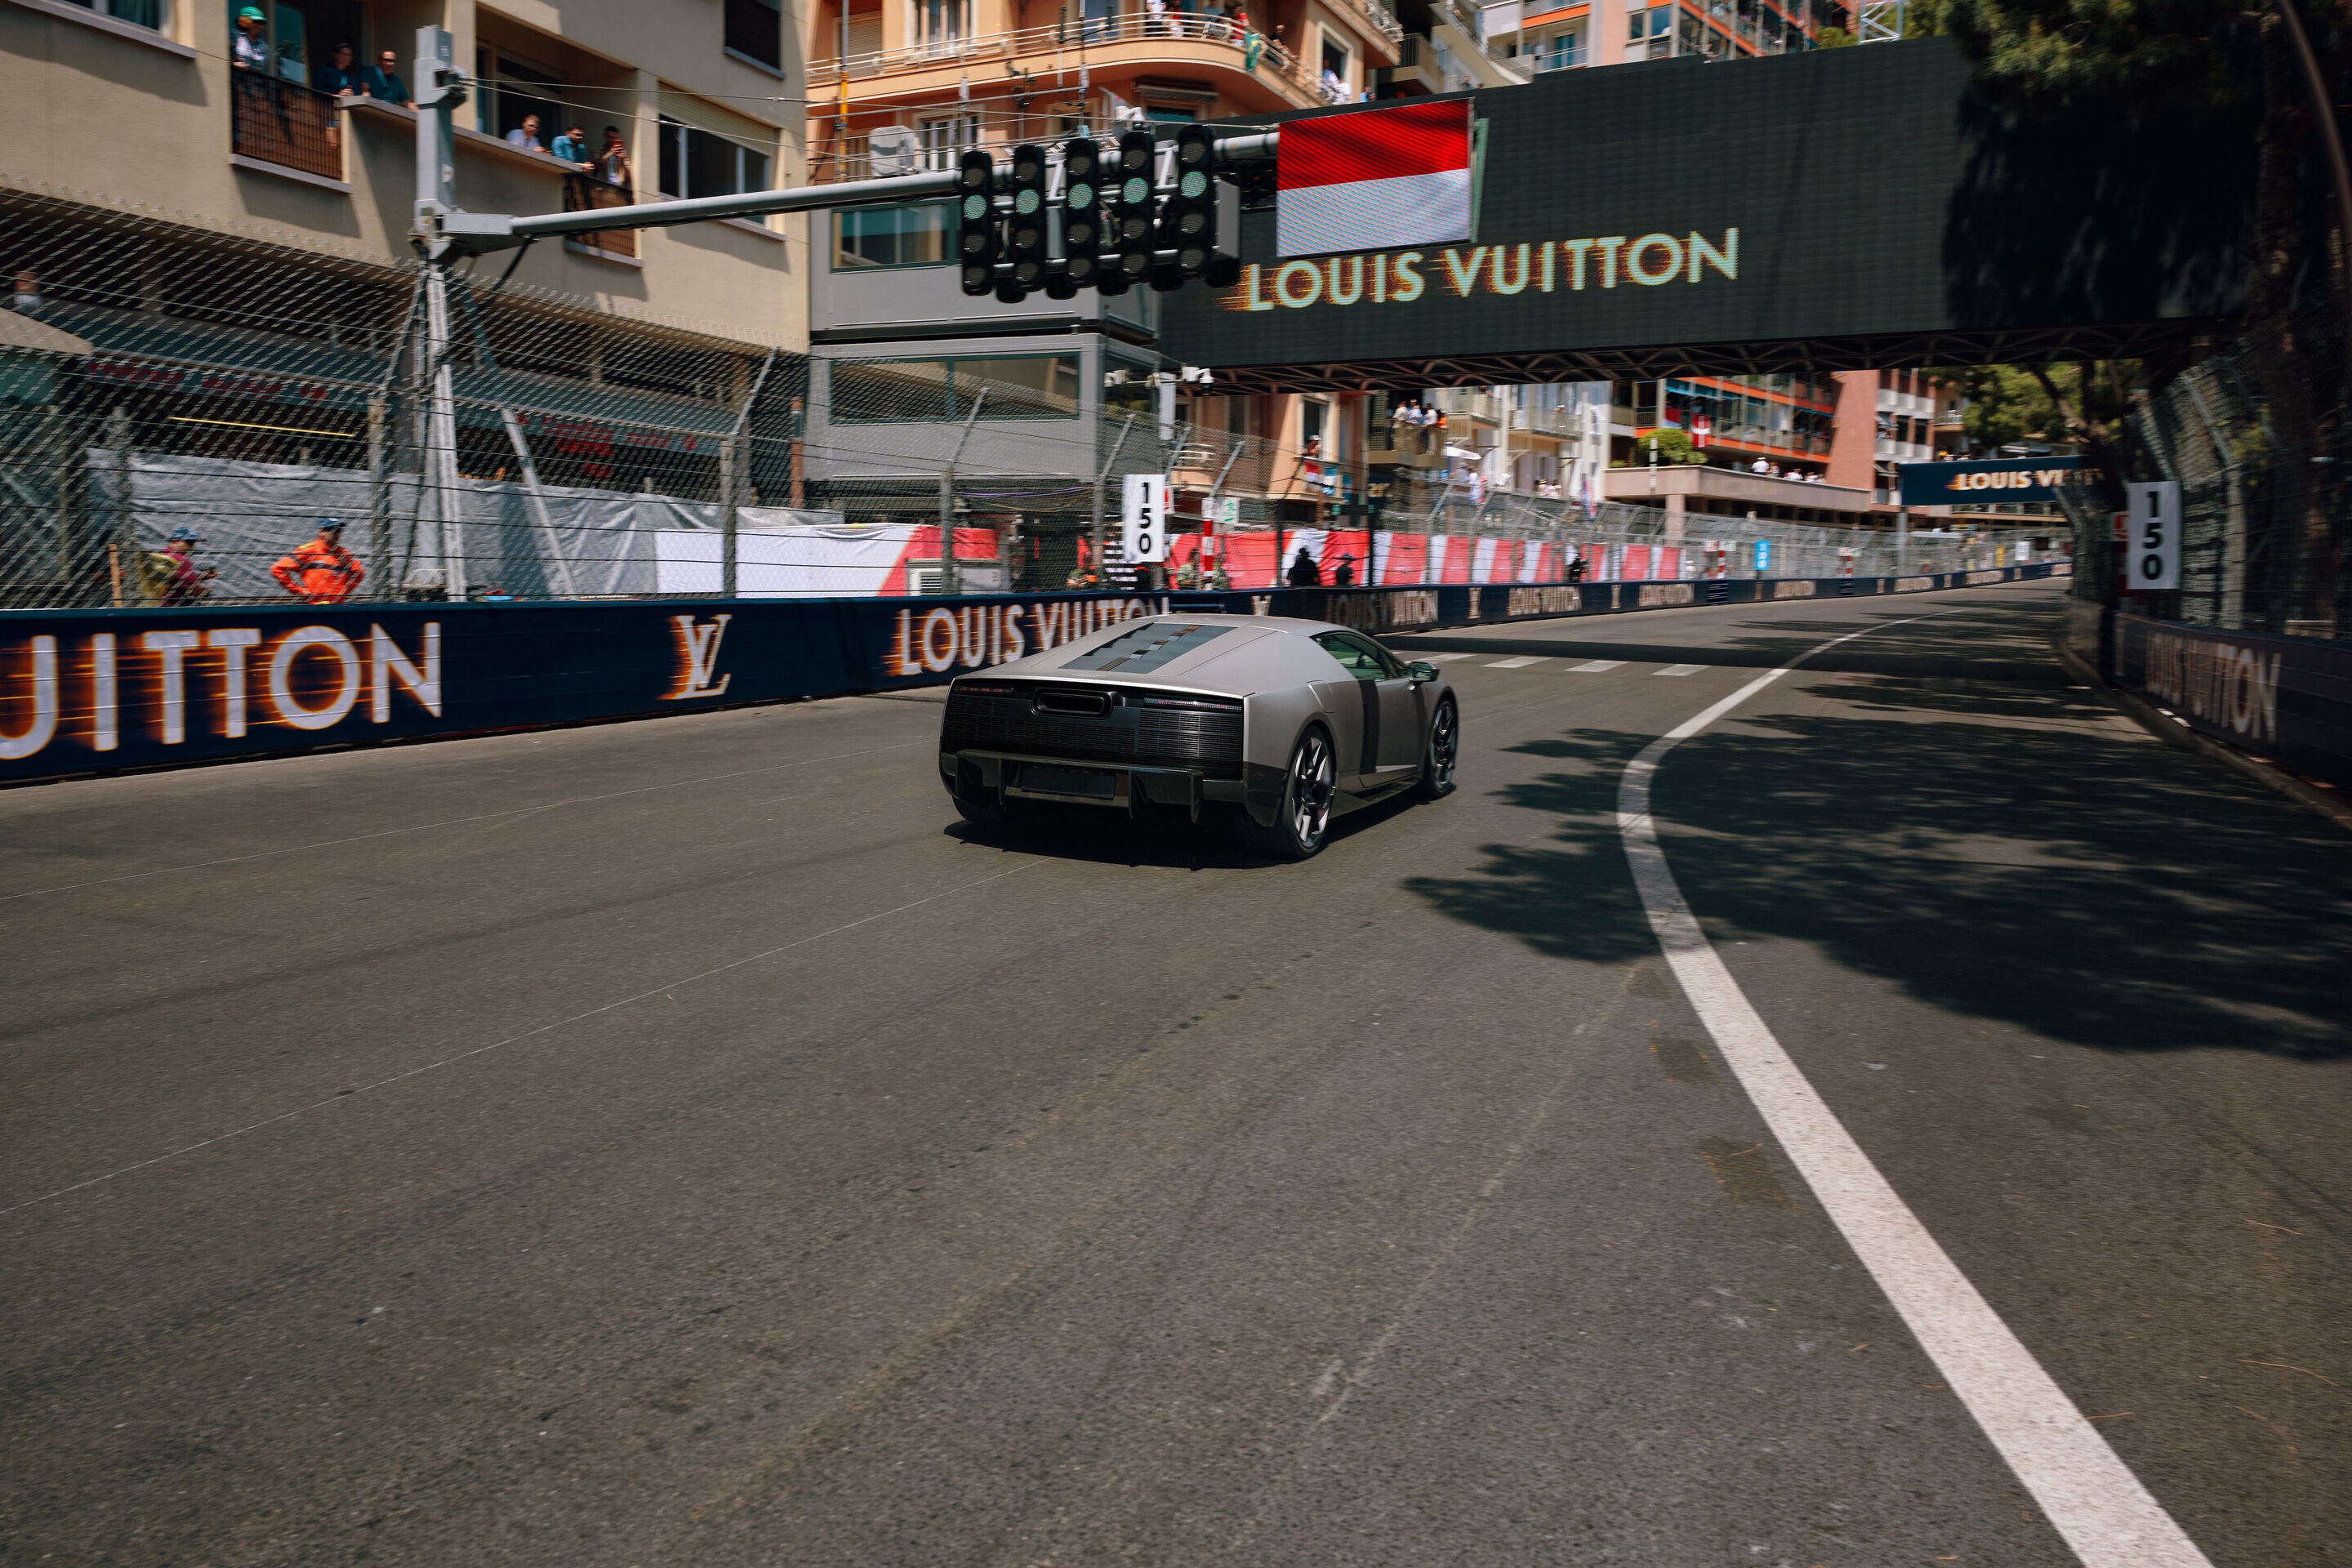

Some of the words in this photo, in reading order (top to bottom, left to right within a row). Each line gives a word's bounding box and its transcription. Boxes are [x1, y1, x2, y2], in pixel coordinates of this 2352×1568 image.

[1245, 252, 1426, 312] LOUIS
[1443, 226, 1740, 298] VUITTON
[1957, 470, 2033, 491] LOUIS
[1138, 482, 1152, 555] 150
[2141, 491, 2164, 581] 150
[899, 604, 1026, 676] LOUIS
